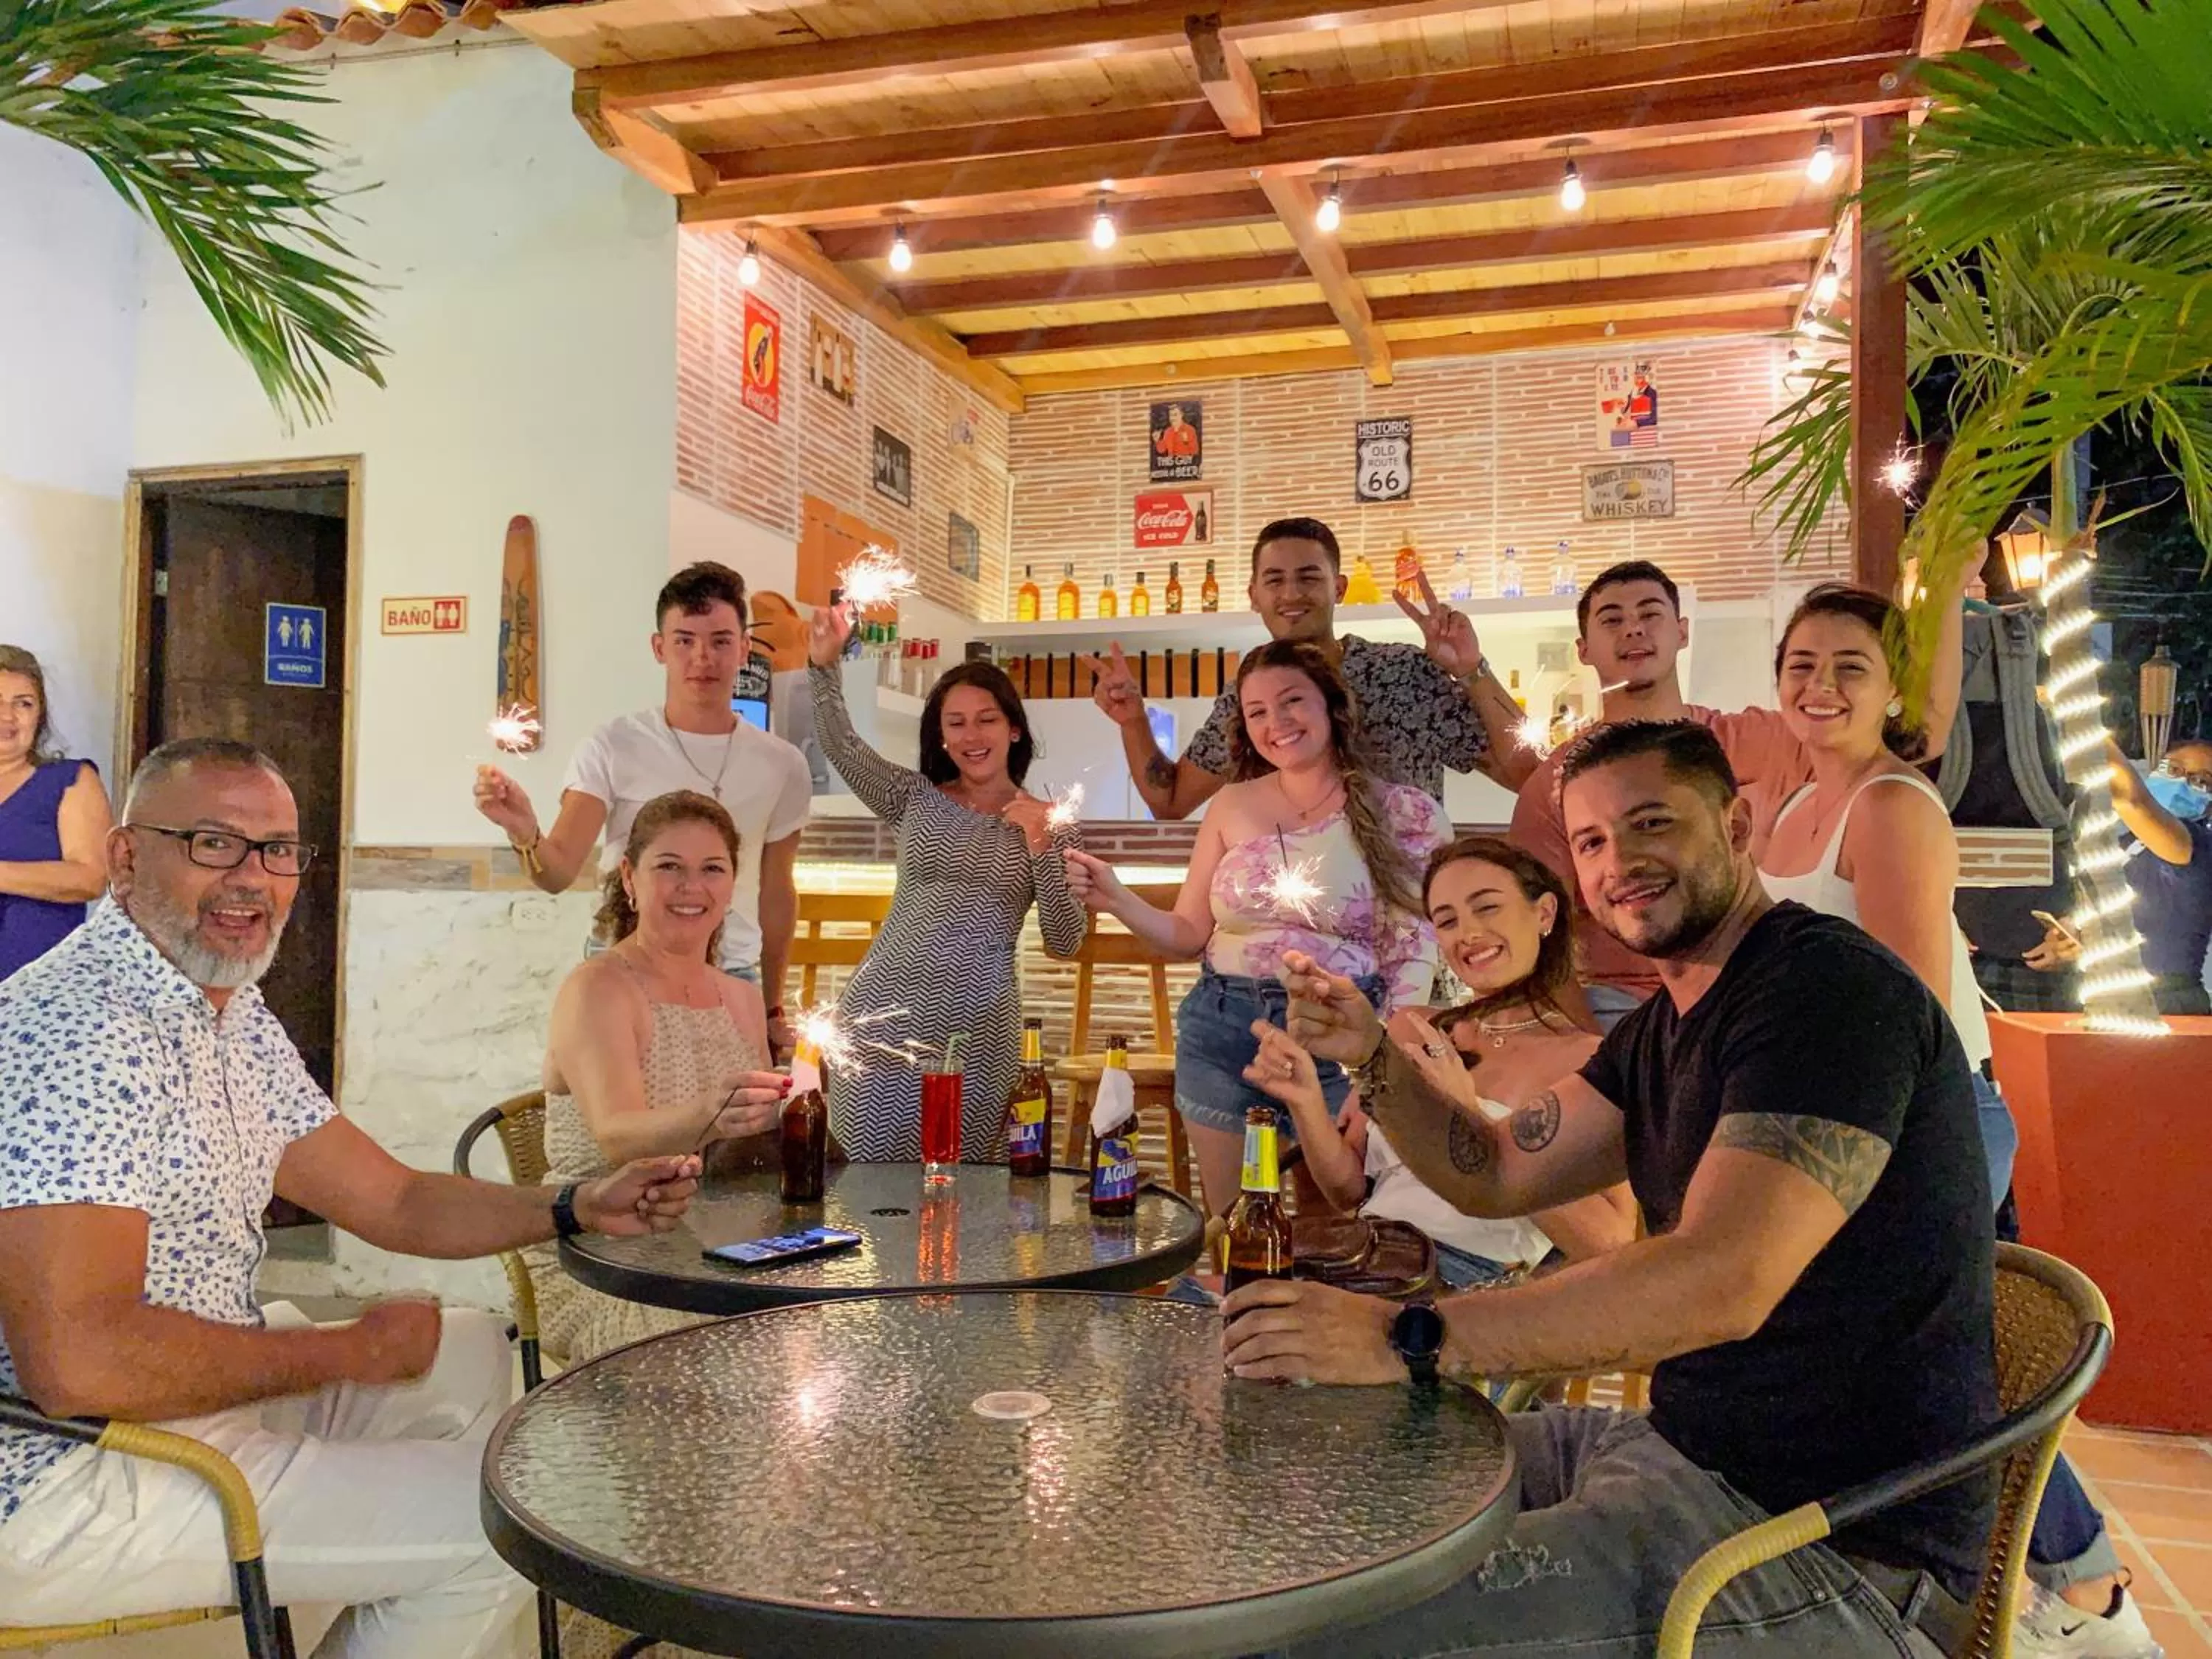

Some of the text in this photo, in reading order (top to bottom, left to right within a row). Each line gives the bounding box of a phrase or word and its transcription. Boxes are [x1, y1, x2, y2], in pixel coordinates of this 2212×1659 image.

[1357, 420, 1410, 436] HISTORIC
[1372, 445, 1396, 456] OLD
[1368, 458, 1399, 467] ROUTE
[1368, 470, 1399, 492] 66
[1590, 498, 1668, 517] WHISKEY
[388, 605, 431, 626] BAÑO
